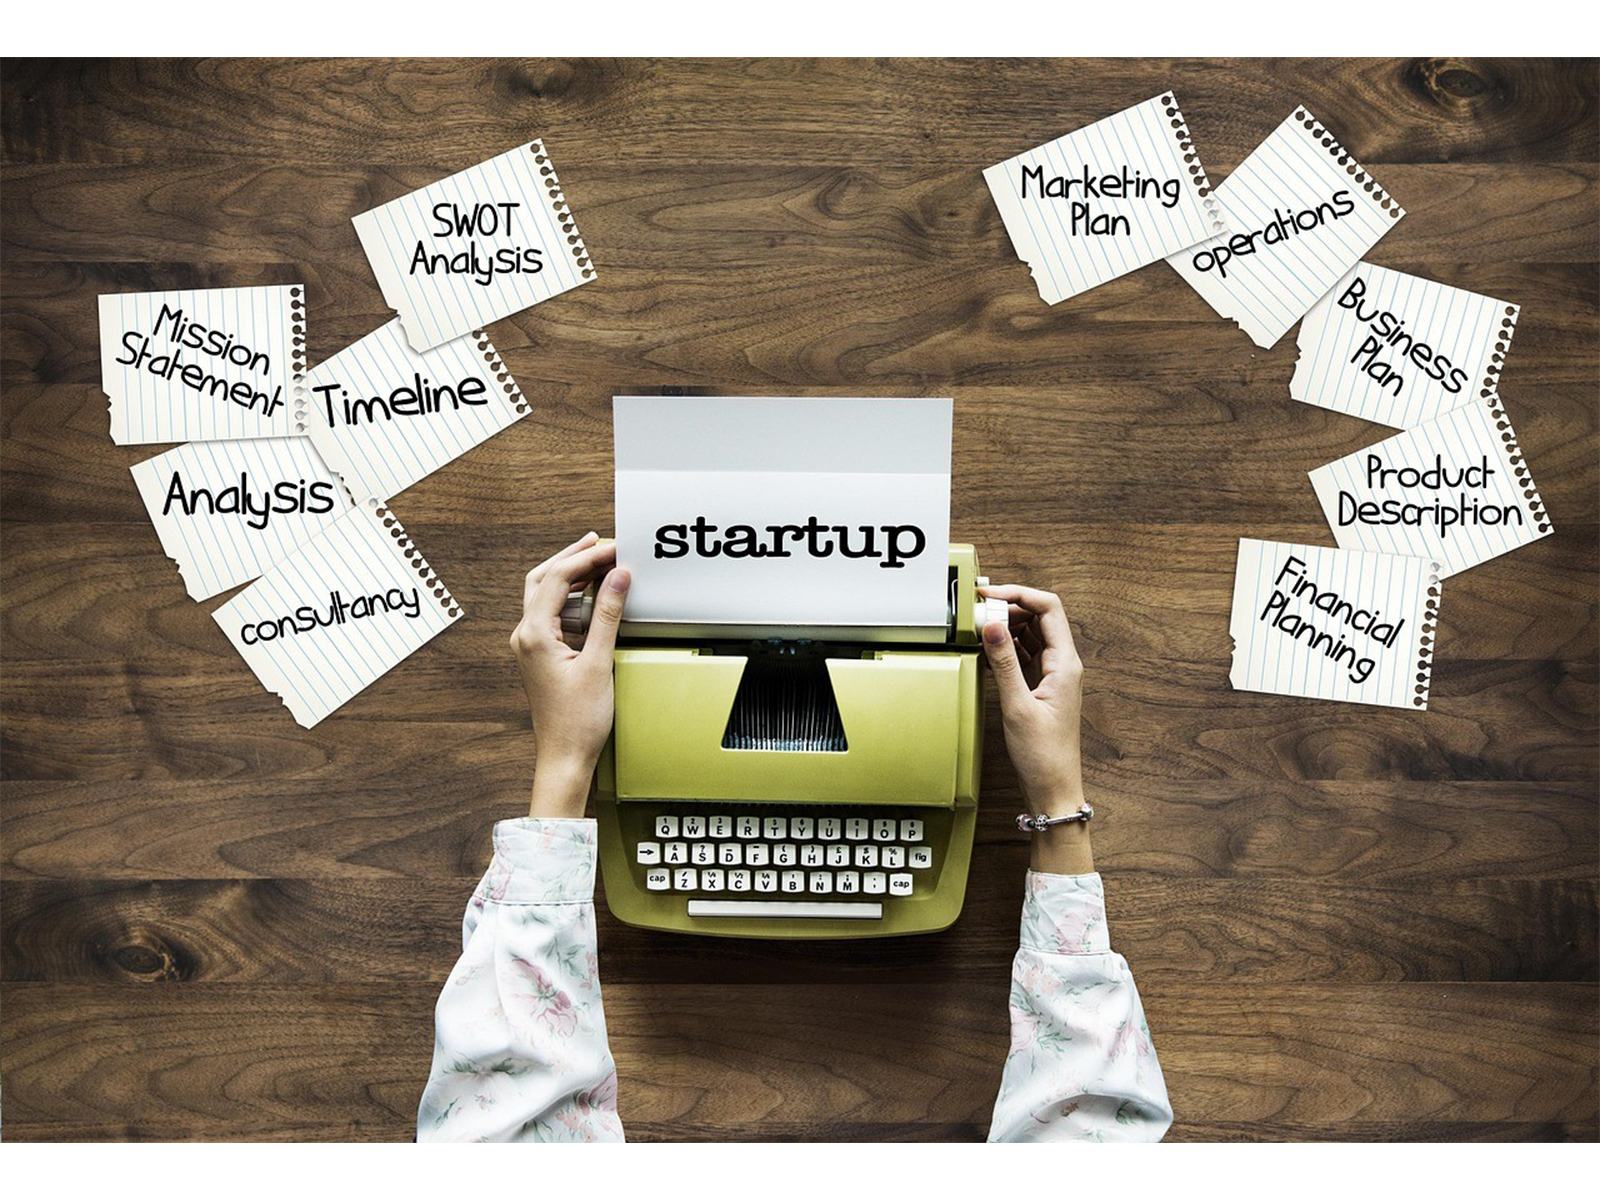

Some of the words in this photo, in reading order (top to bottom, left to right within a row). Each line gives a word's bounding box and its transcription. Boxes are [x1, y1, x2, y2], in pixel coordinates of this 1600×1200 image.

[1021, 164, 1181, 209] Marketing
[432, 202, 521, 238] SWOT
[1071, 201, 1131, 237] Plan
[1192, 190, 1355, 279] operations
[409, 240, 543, 287] Analysis
[152, 303, 270, 376] Mission
[1337, 276, 1469, 394] Business
[1350, 335, 1404, 397] Plan
[115, 331, 285, 418] Statement
[312, 372, 488, 428] Timeline
[1367, 453, 1496, 490] Product
[162, 470, 334, 530] Analysis
[1338, 490, 1523, 539] Description
[654, 516, 926, 569] startup
[1274, 555, 1406, 649] Financial
[240, 587, 421, 646] consultancy
[1260, 589, 1376, 684] Planning
[661, 825, 670, 835] Q
[687, 826, 699, 835] W
[717, 826, 723, 835] E
[744, 826, 752, 836] R
[771, 827, 779, 837] T
[798, 827, 806, 837] Y
[825, 828, 833, 837] U
[880, 829, 889, 839] O
[908, 830, 916, 839] P
[671, 853, 678, 861] A
[699, 853, 706, 862] S
[725, 853, 734, 862] D
[753, 854, 759, 863] F
[779, 854, 788, 863] G
[808, 855, 816, 864] H
[835, 855, 842, 864] J
[862, 856, 871, 865] K
[890, 857, 896, 866] L
[915, 853, 927, 862] fig
[649, 875, 666, 883] cap
[681, 879, 688, 888] Z
[708, 880, 716, 889] X
[734, 880, 742, 889] C
[762, 881, 770, 890] V
[789, 882, 797, 890] B
[816, 882, 824, 891] N
[843, 882, 852, 891] M
[893, 881, 910, 889] cap
